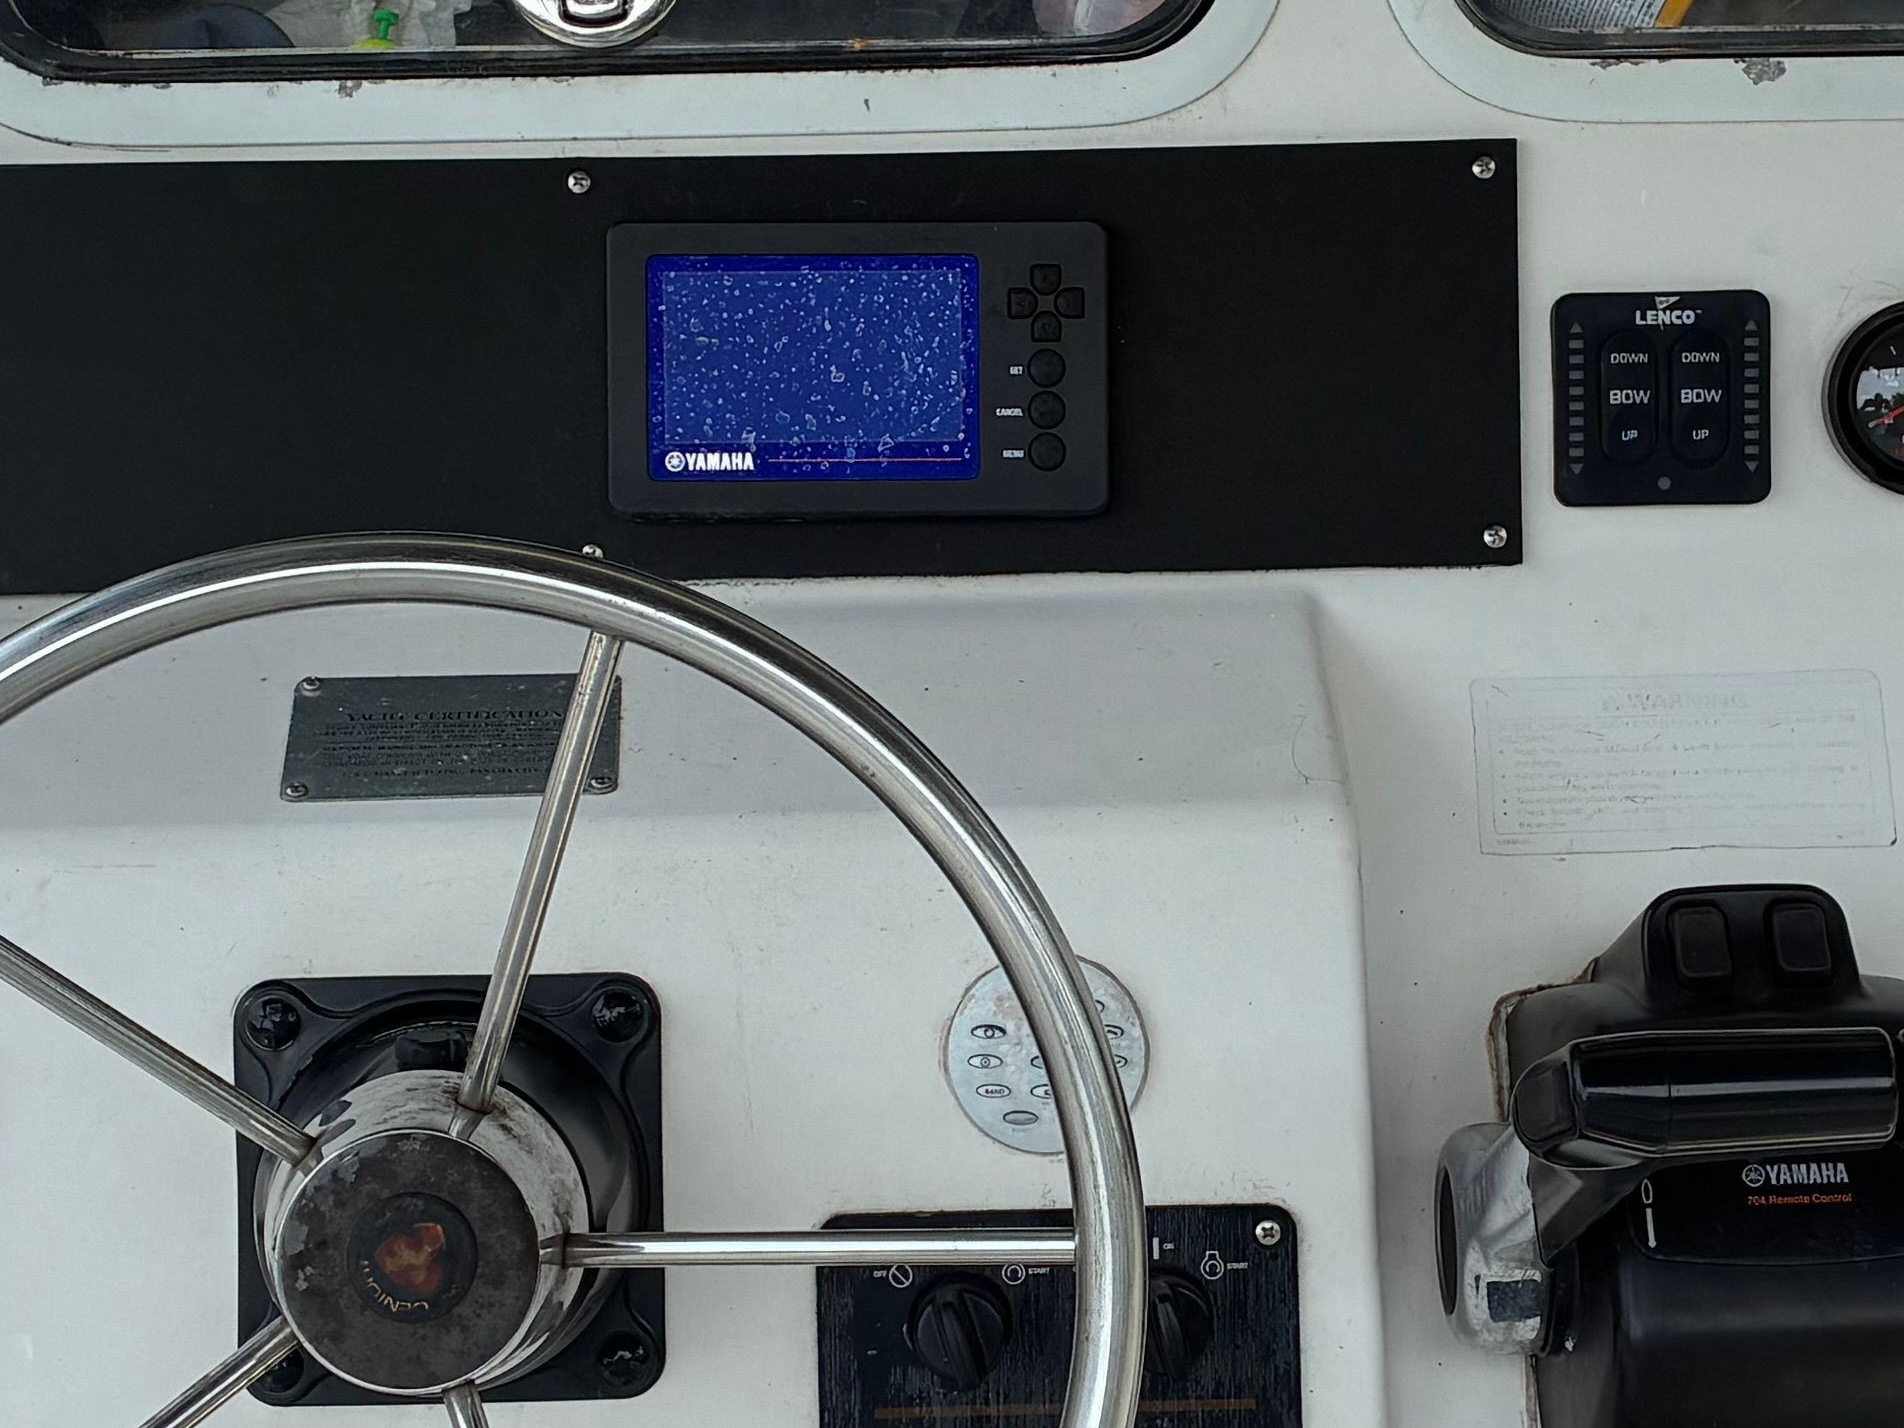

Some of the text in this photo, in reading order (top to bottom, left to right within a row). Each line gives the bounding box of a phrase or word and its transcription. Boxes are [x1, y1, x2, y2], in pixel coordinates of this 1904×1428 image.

[1634, 309, 1696, 325] LENCO
[1610, 352, 1649, 365] DOWN
[1681, 351, 1720, 364] DOWN
[1609, 389, 1651, 404] BOW
[1680, 388, 1722, 403] BOW
[1621, 429, 1638, 441] UP
[1692, 429, 1710, 441] UP
[685, 451, 755, 471] YAMAHA
[1765, 1162, 1850, 1185] YAMAHA
[1769, 1194, 1810, 1205] Remote
[1811, 1193, 1853, 1204] Control
